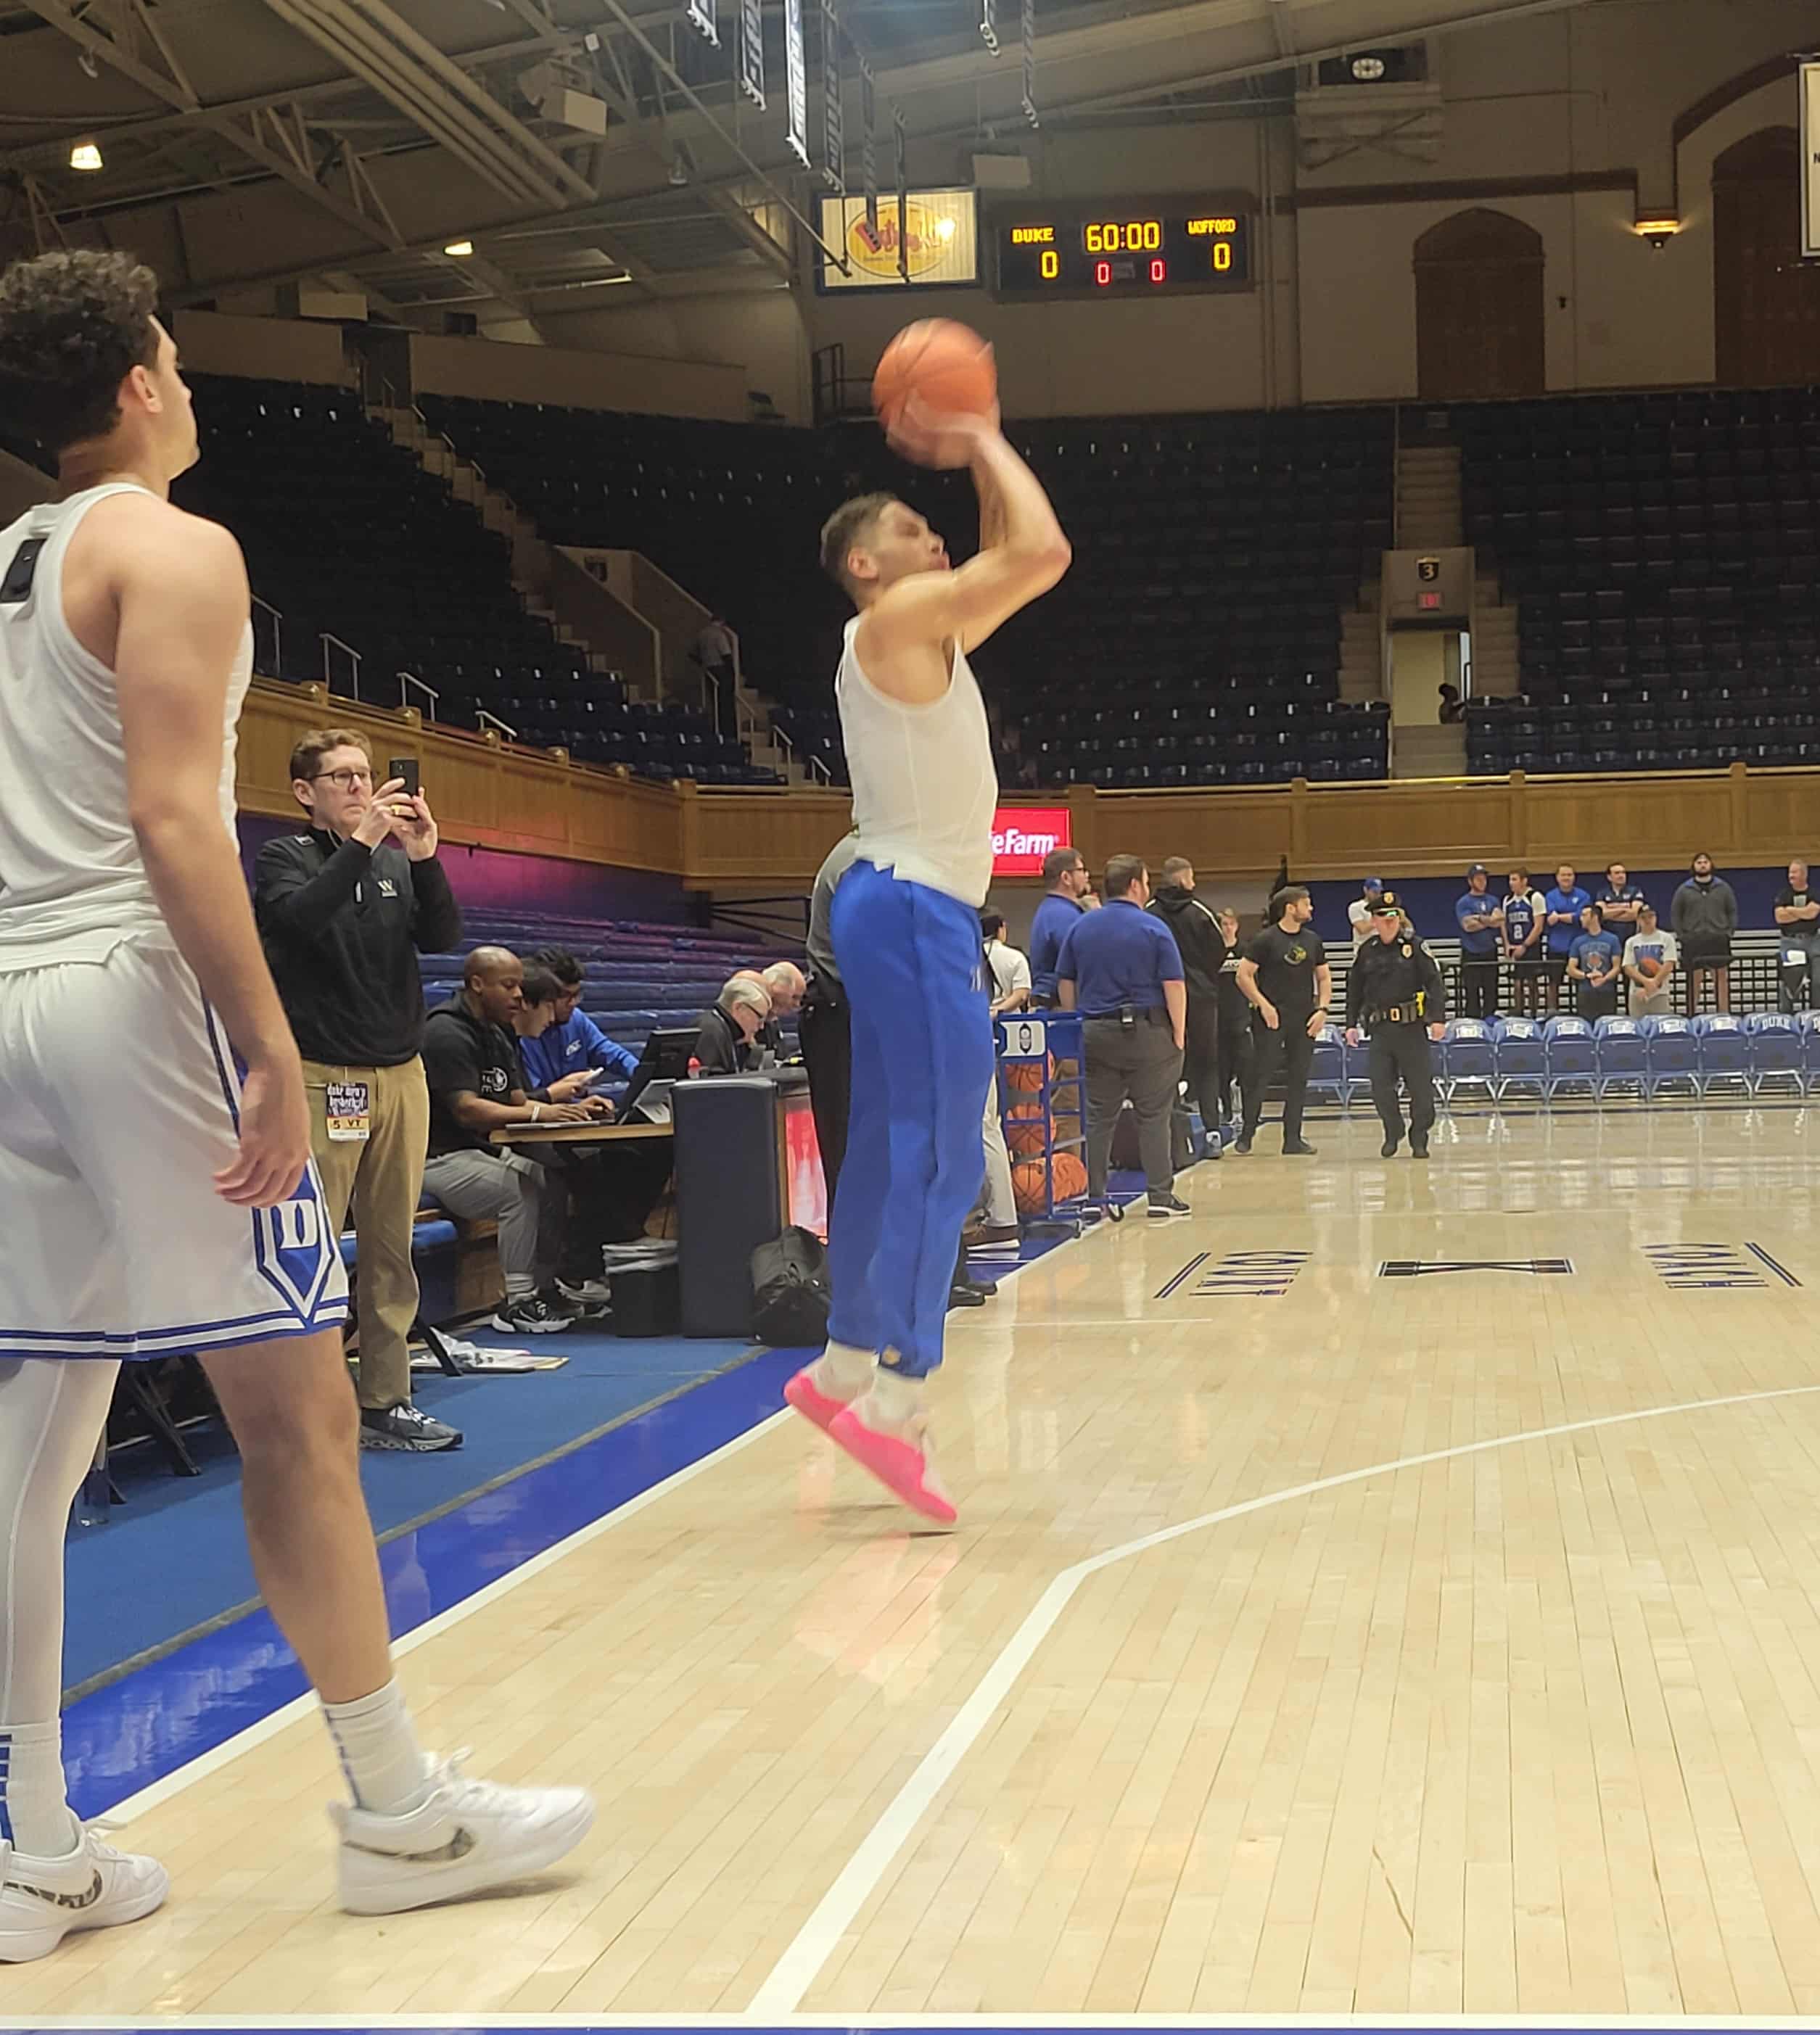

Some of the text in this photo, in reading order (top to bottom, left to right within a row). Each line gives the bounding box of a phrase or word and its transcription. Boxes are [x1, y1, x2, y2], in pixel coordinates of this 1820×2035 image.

[1012, 227, 1054, 244] DUKE
[1087, 222, 1161, 252] 60:00
[1187, 219, 1237, 234] WOFFORD
[1042, 251, 1058, 278] 0
[1213, 243, 1231, 270] 0
[1097, 263, 1110, 284] 0
[1151, 260, 1164, 281] 0
[1423, 564, 1434, 579] 3
[1762, 1016, 1790, 1029] DUKE
[1000, 1020, 1045, 1057] D
[279, 1199, 318, 1249] D
